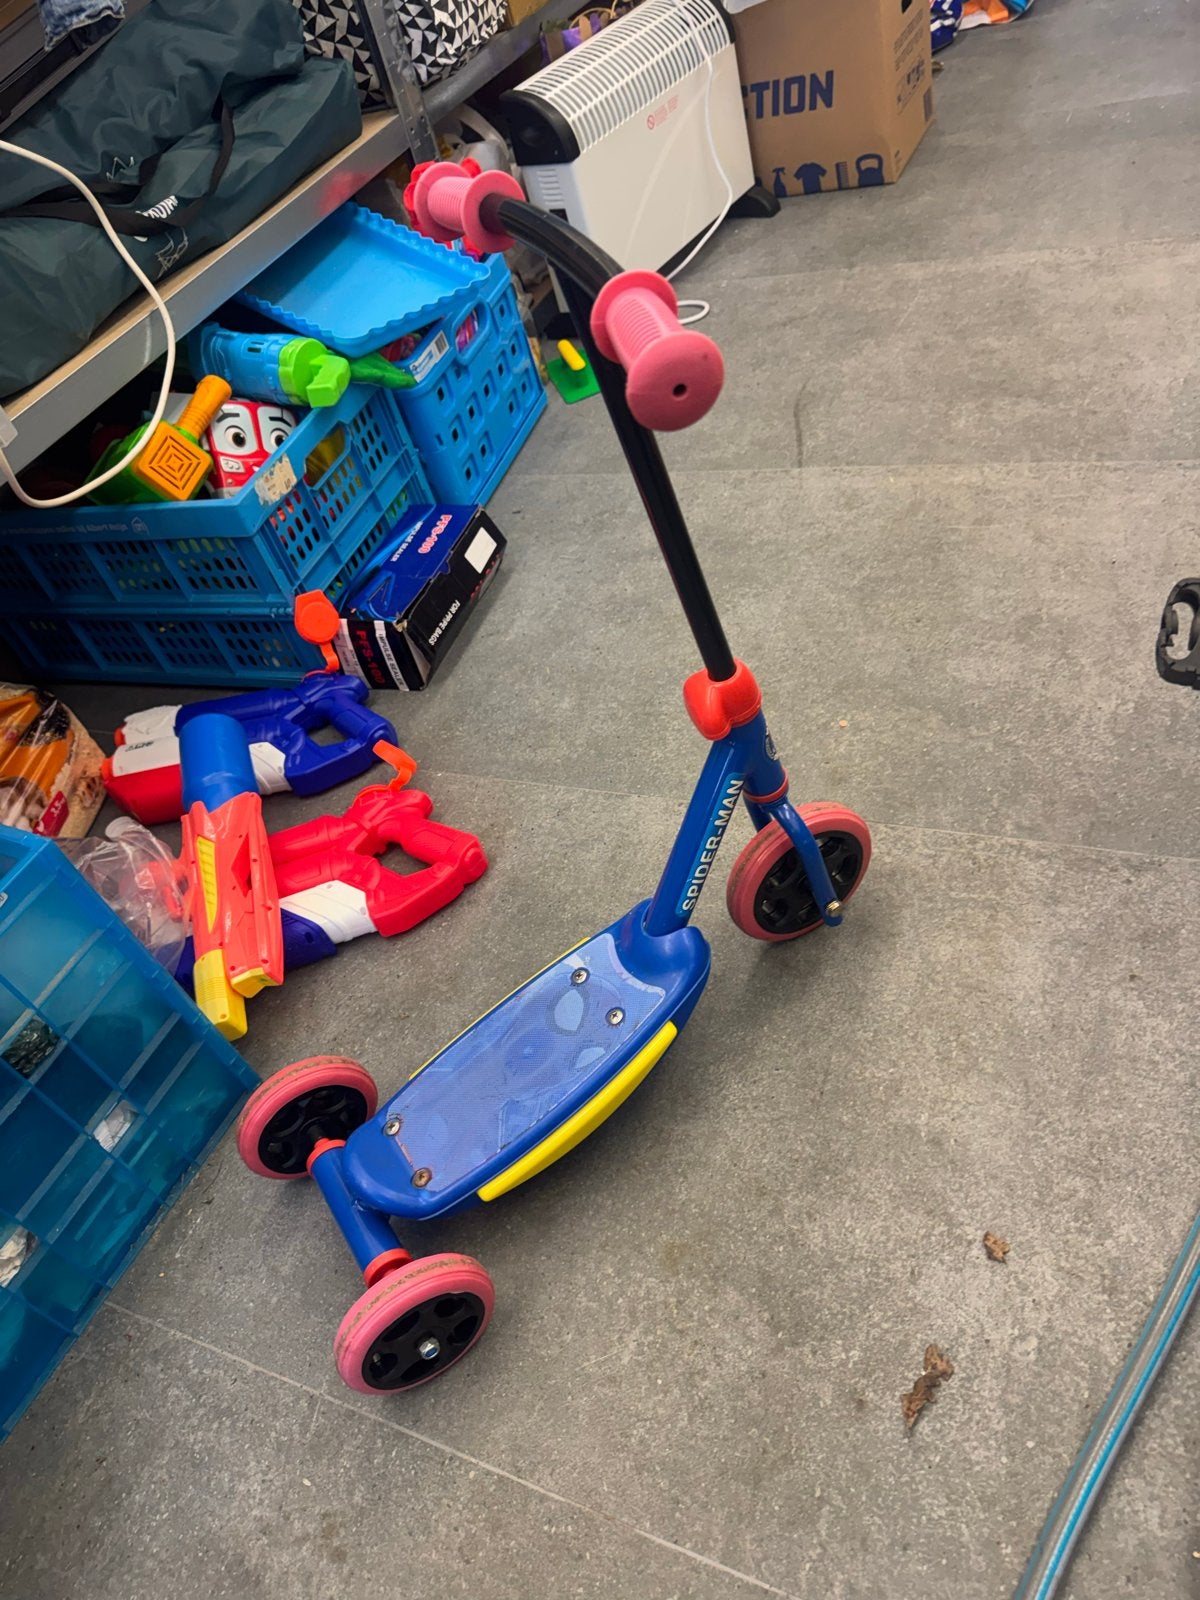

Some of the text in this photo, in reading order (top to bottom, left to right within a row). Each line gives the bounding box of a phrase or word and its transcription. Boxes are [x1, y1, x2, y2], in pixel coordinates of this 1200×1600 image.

[448, 599, 460, 614] FOR
[354, 629, 385, 683] PFS-100
[378, 633, 404, 686] IMPULSE SEALER
[427, 626, 442, 646] BAGS
[682, 779, 744, 911] SPIDER-MAN
